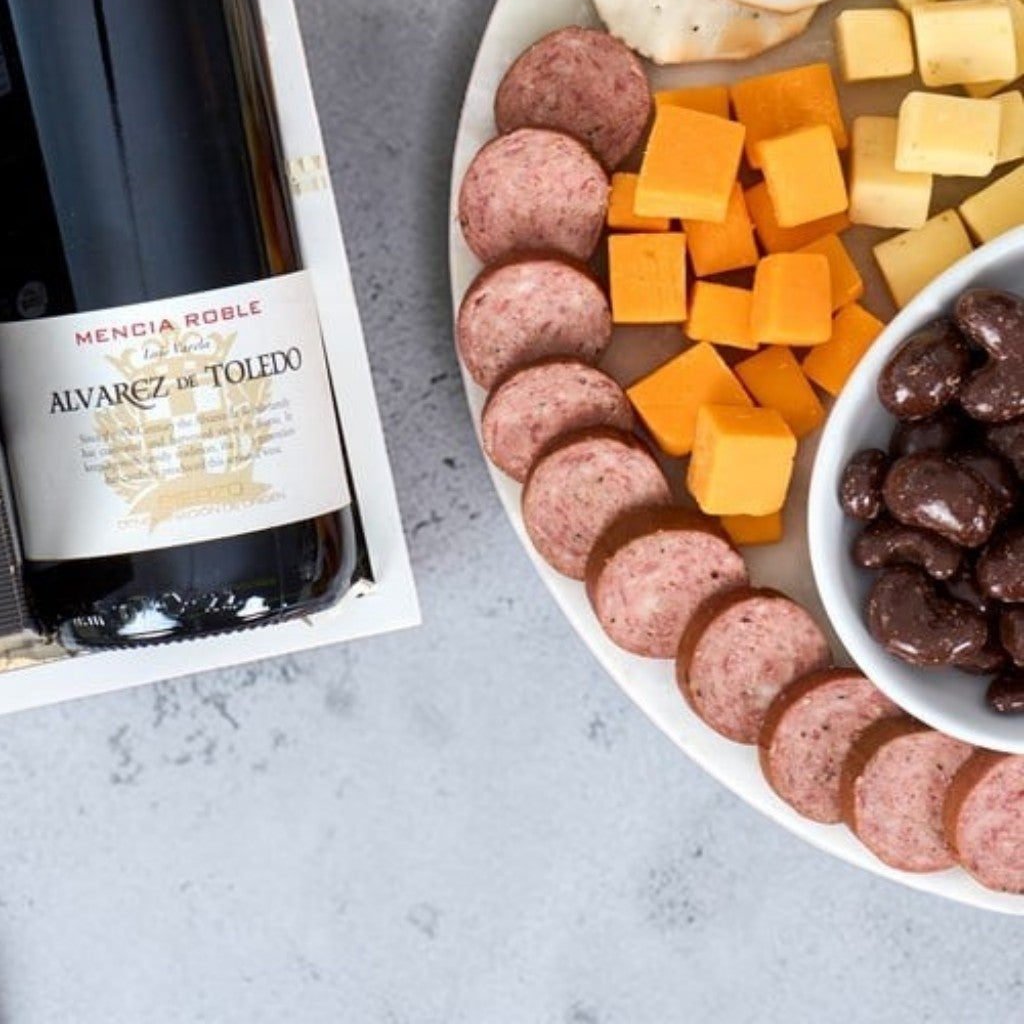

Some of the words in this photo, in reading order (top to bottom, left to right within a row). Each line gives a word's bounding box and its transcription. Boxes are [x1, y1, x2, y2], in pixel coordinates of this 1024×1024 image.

[74, 319, 175, 347] MENCIA
[184, 300, 263, 327] ROBLE
[49, 375, 172, 416] ALVAREZ
[176, 373, 200, 392] DE
[204, 346, 303, 389] TOLEDO
